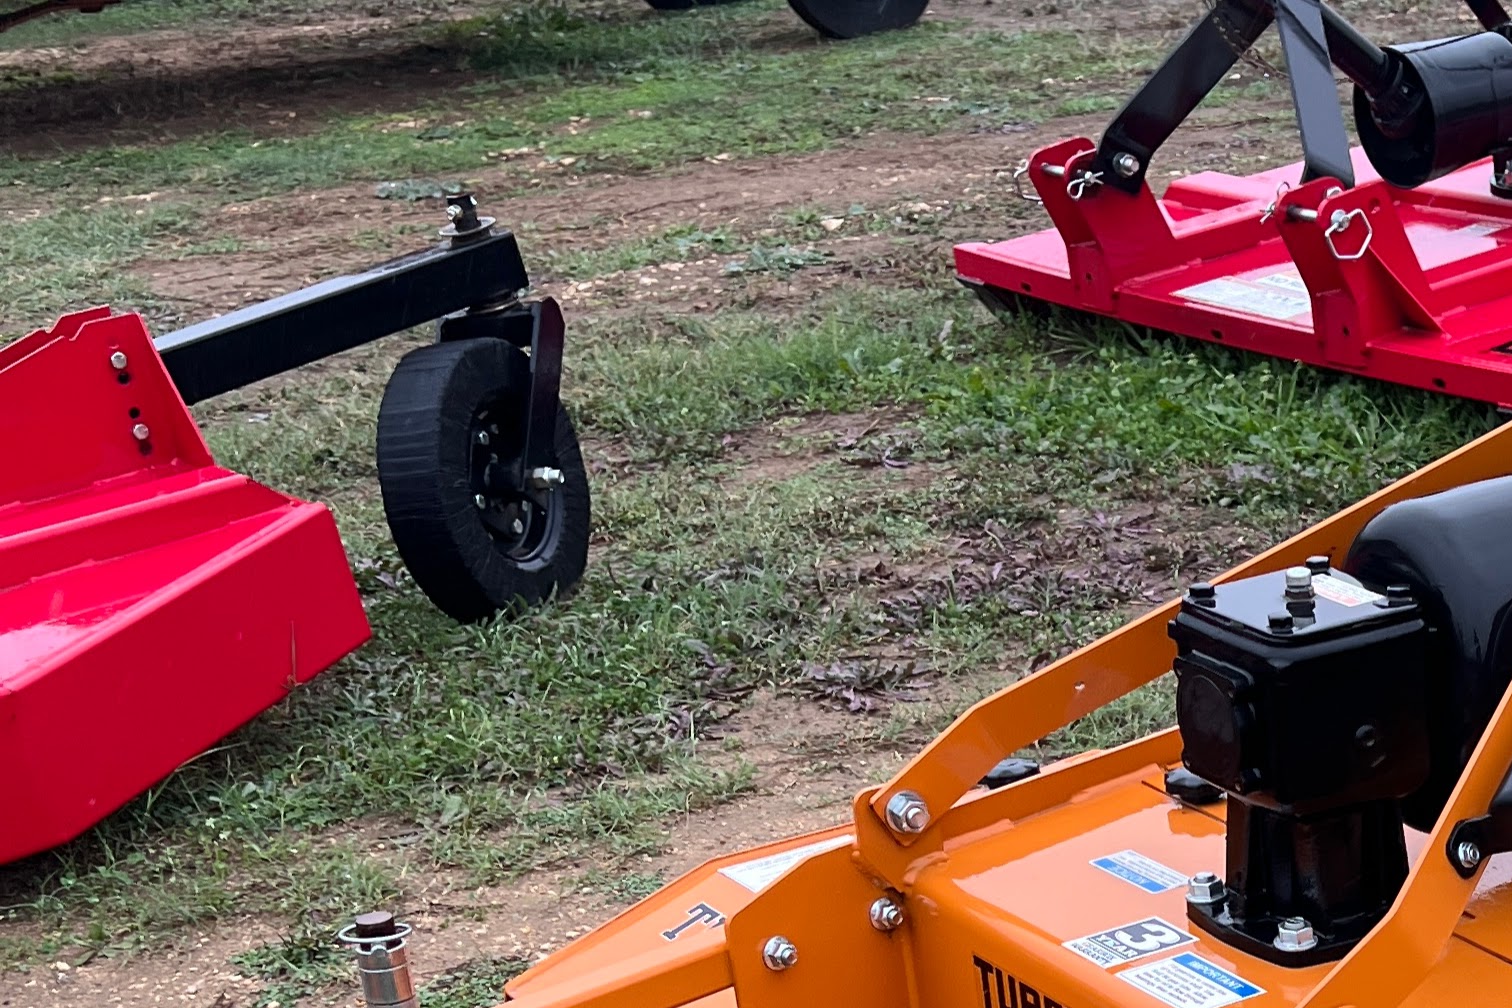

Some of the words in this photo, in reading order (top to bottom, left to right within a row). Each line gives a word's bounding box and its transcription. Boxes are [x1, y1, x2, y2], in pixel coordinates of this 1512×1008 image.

[1096, 934, 1138, 957] YEAR
[1115, 923, 1181, 950] 3
[1185, 960, 1246, 990] IMPORTANT
